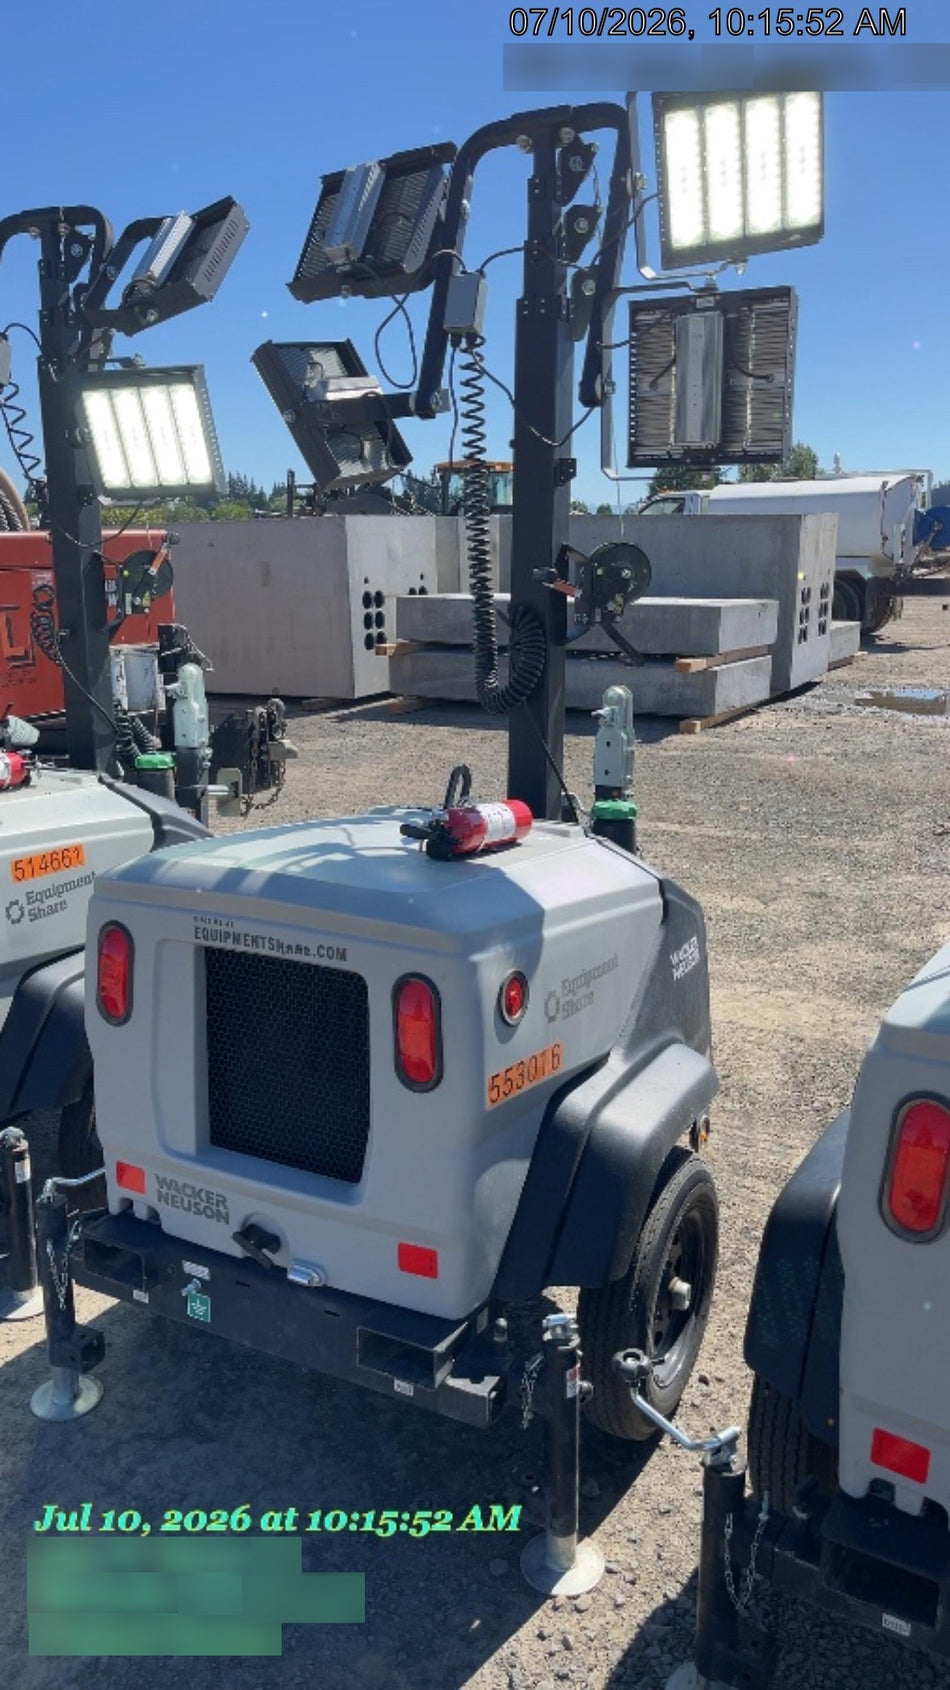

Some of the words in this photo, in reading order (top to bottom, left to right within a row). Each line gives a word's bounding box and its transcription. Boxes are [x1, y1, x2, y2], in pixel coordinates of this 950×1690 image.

[14, 847, 81, 882] 514661
[25, 870, 96, 905] Equipment
[28, 899, 68, 922] Share
[560, 953, 620, 997] Equipment
[489, 1043, 561, 1104] 553016
[153, 1172, 229, 1210] WACKER
[156, 1187, 230, 1225] NEUSON
